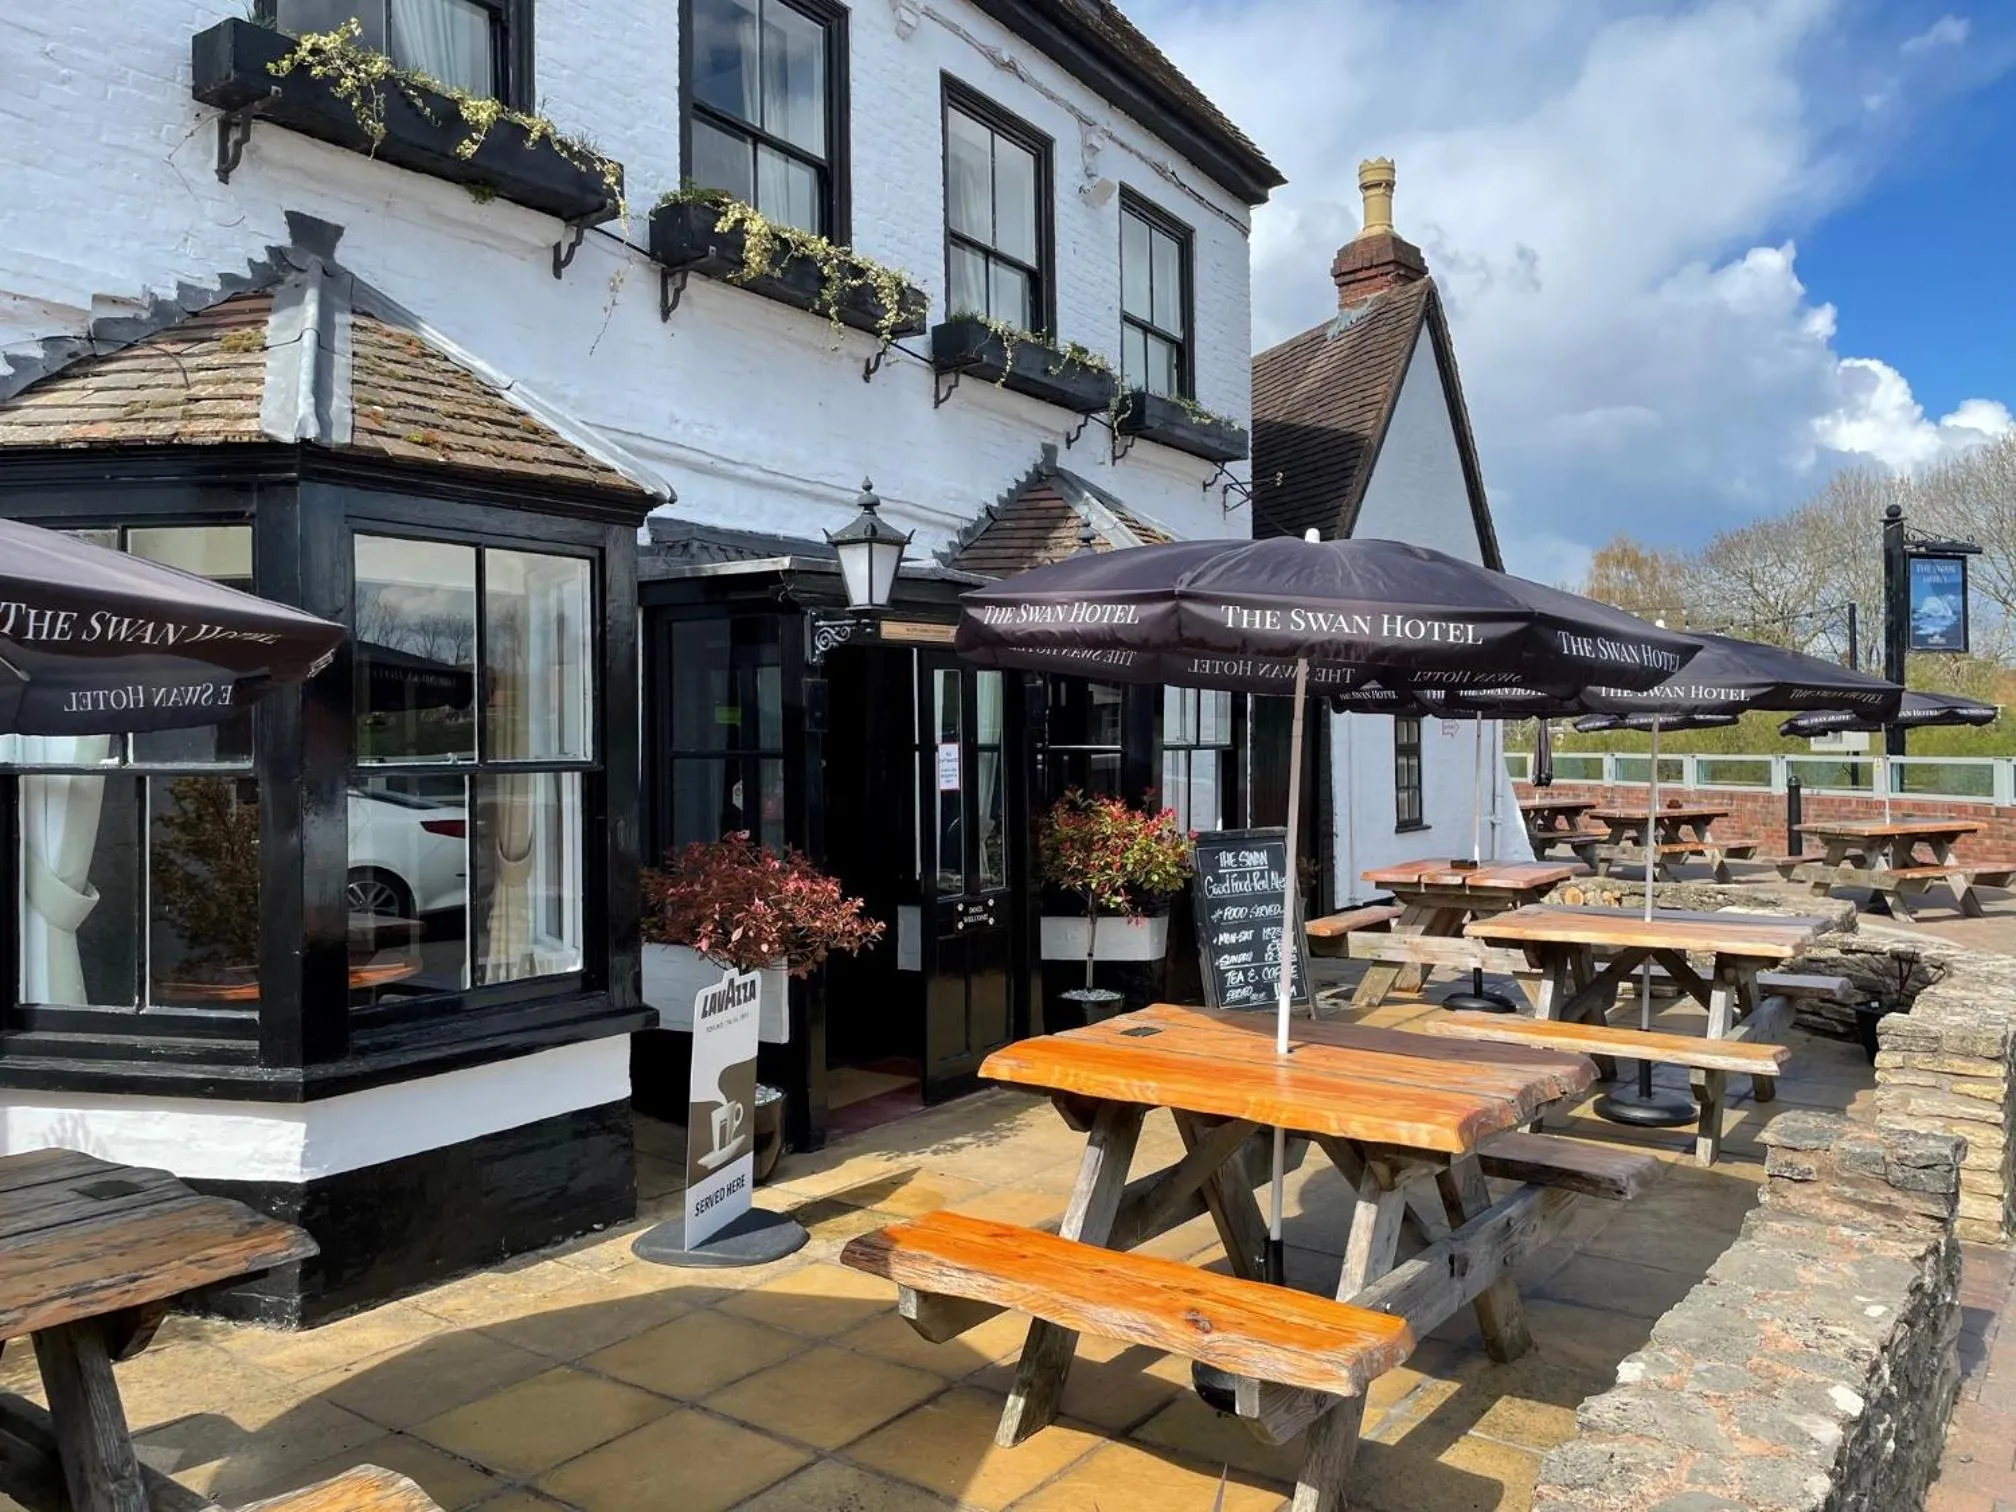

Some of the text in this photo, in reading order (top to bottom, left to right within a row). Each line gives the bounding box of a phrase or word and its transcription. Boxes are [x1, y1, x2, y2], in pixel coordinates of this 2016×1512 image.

[1, 601, 77, 641] THE
[82, 611, 187, 647] SWAN
[983, 602, 1139, 625] THE SWAN HOTEL
[1221, 605, 1484, 646] THE SWAN HOTEL
[1557, 631, 1681, 673] THE SWAN HOTEL
[1690, 685, 1751, 702] HOTEL
[1219, 849, 1268, 868] THE SWAN
[1205, 875, 1231, 898] Good
[1223, 905, 1248, 920] FOOD
[1225, 970, 1244, 986] TEA
[701, 977, 756, 1019] LAVAZZA
[694, 1173, 746, 1217] SERVED HERE
